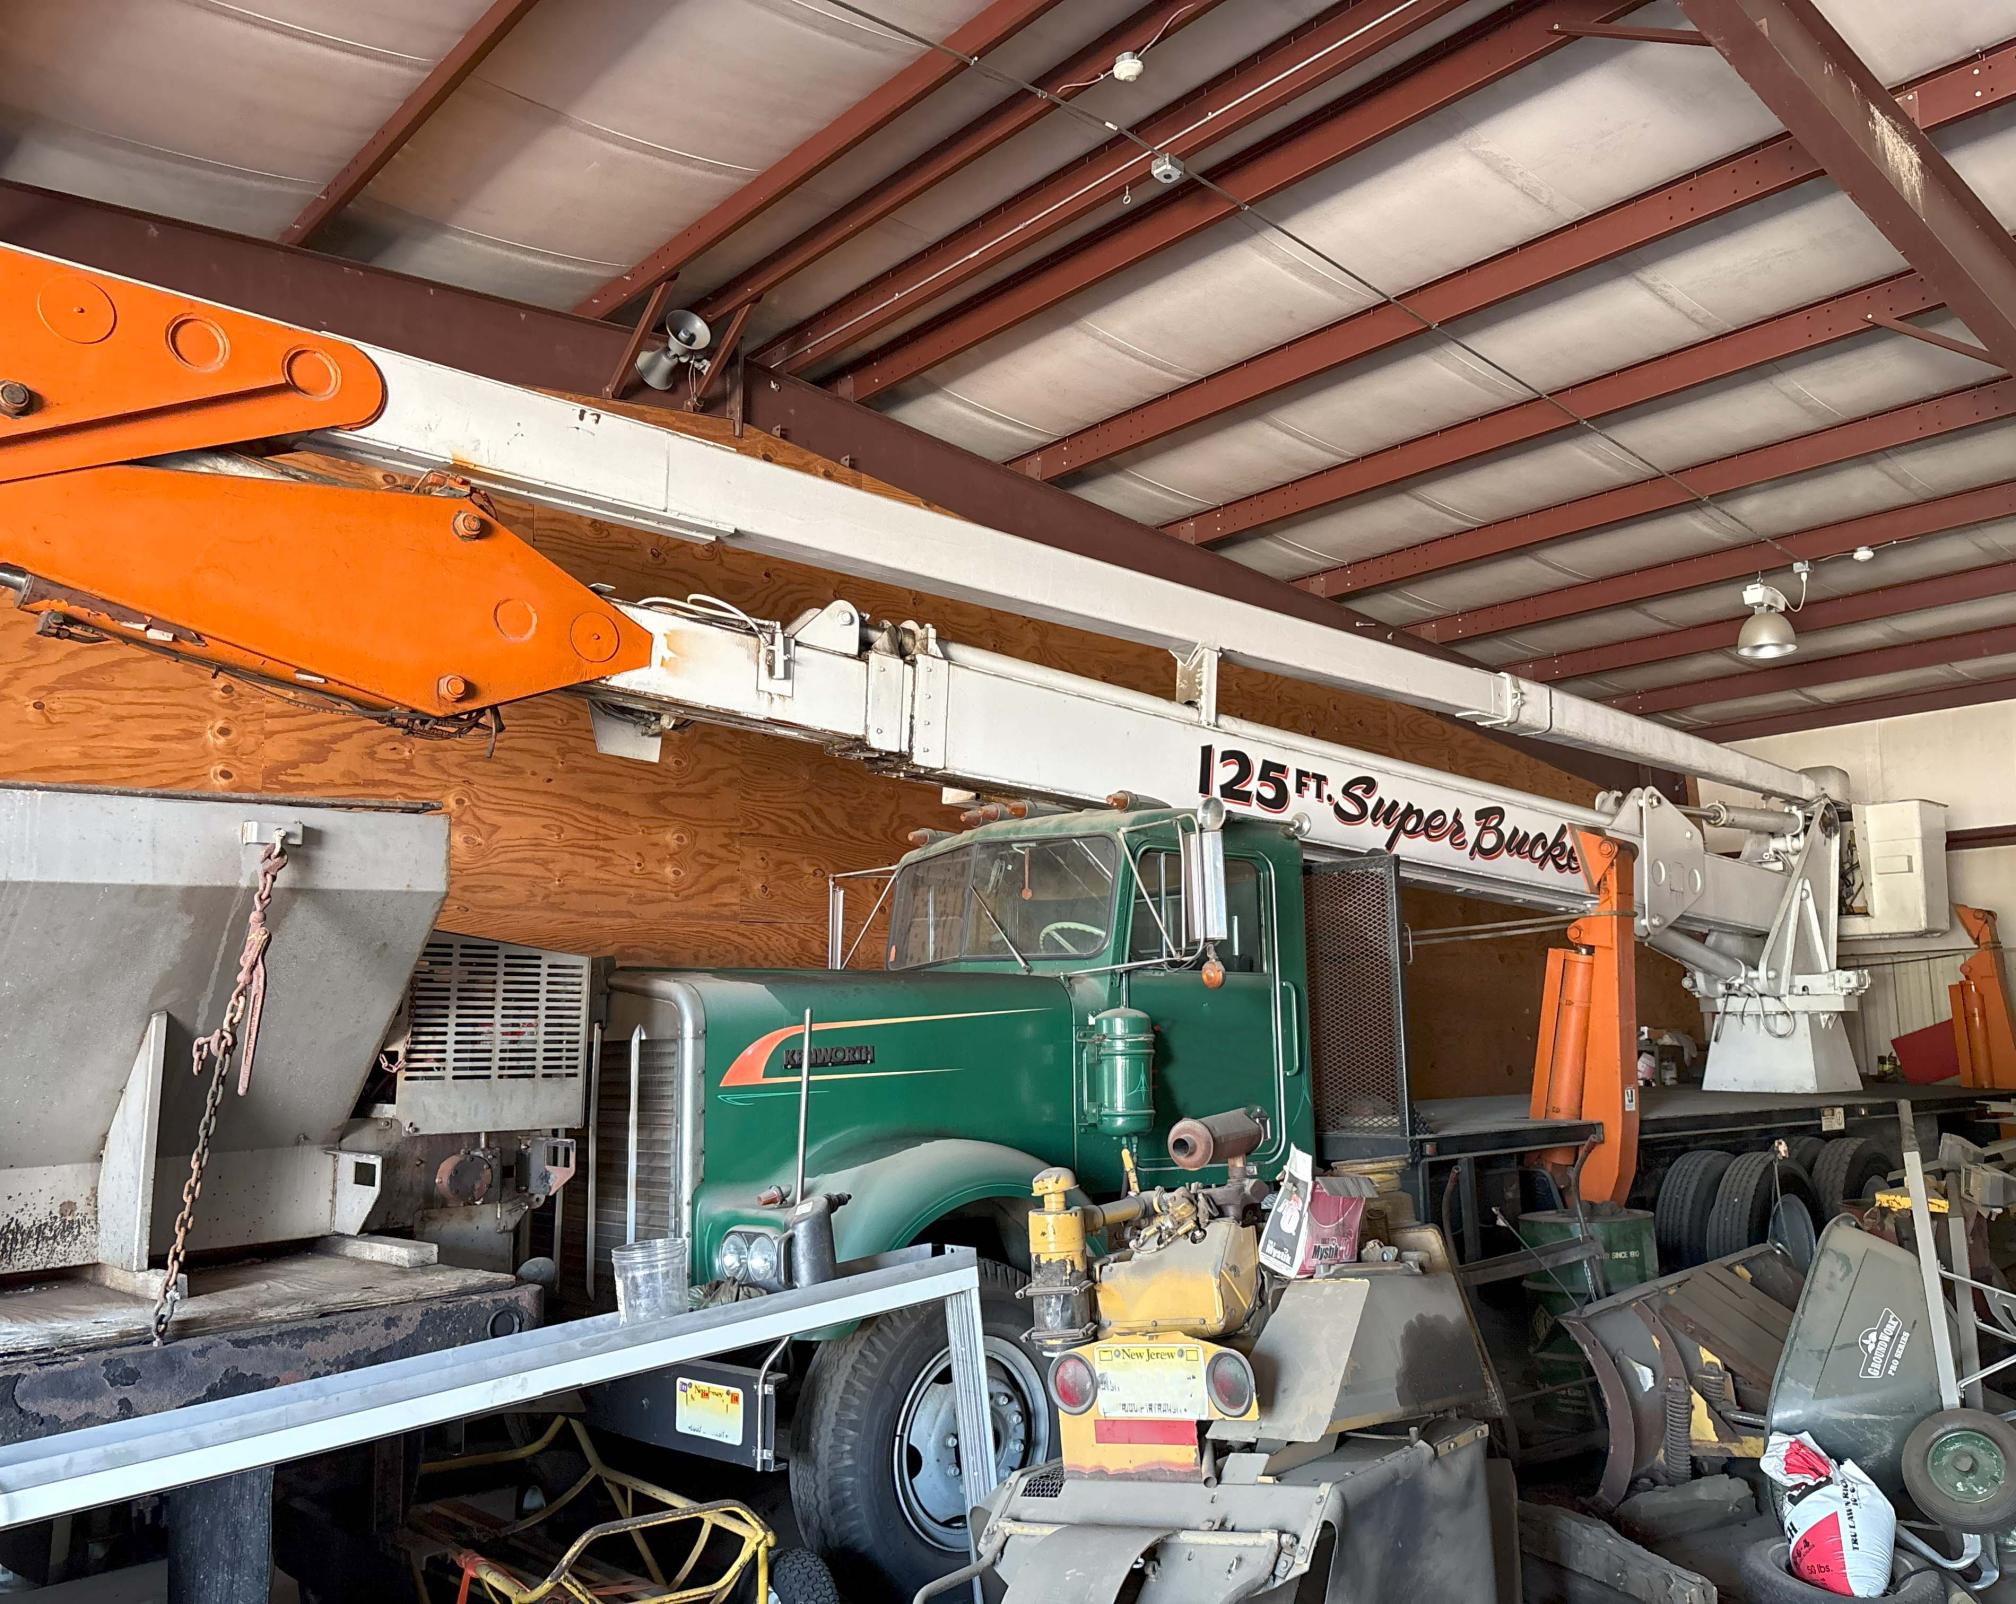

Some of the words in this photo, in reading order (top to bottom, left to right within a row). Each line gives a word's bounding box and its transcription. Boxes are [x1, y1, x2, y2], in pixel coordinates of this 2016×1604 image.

[1198, 744, 1290, 814] 125
[1295, 768, 1334, 805] FT.
[1332, 776, 1468, 857] Super
[1468, 806, 1582, 874] Bucke
[1121, 1348, 1144, 1360] New
[1888, 1359, 1899, 1376] PRO
[1895, 1331, 1910, 1359] SERIES
